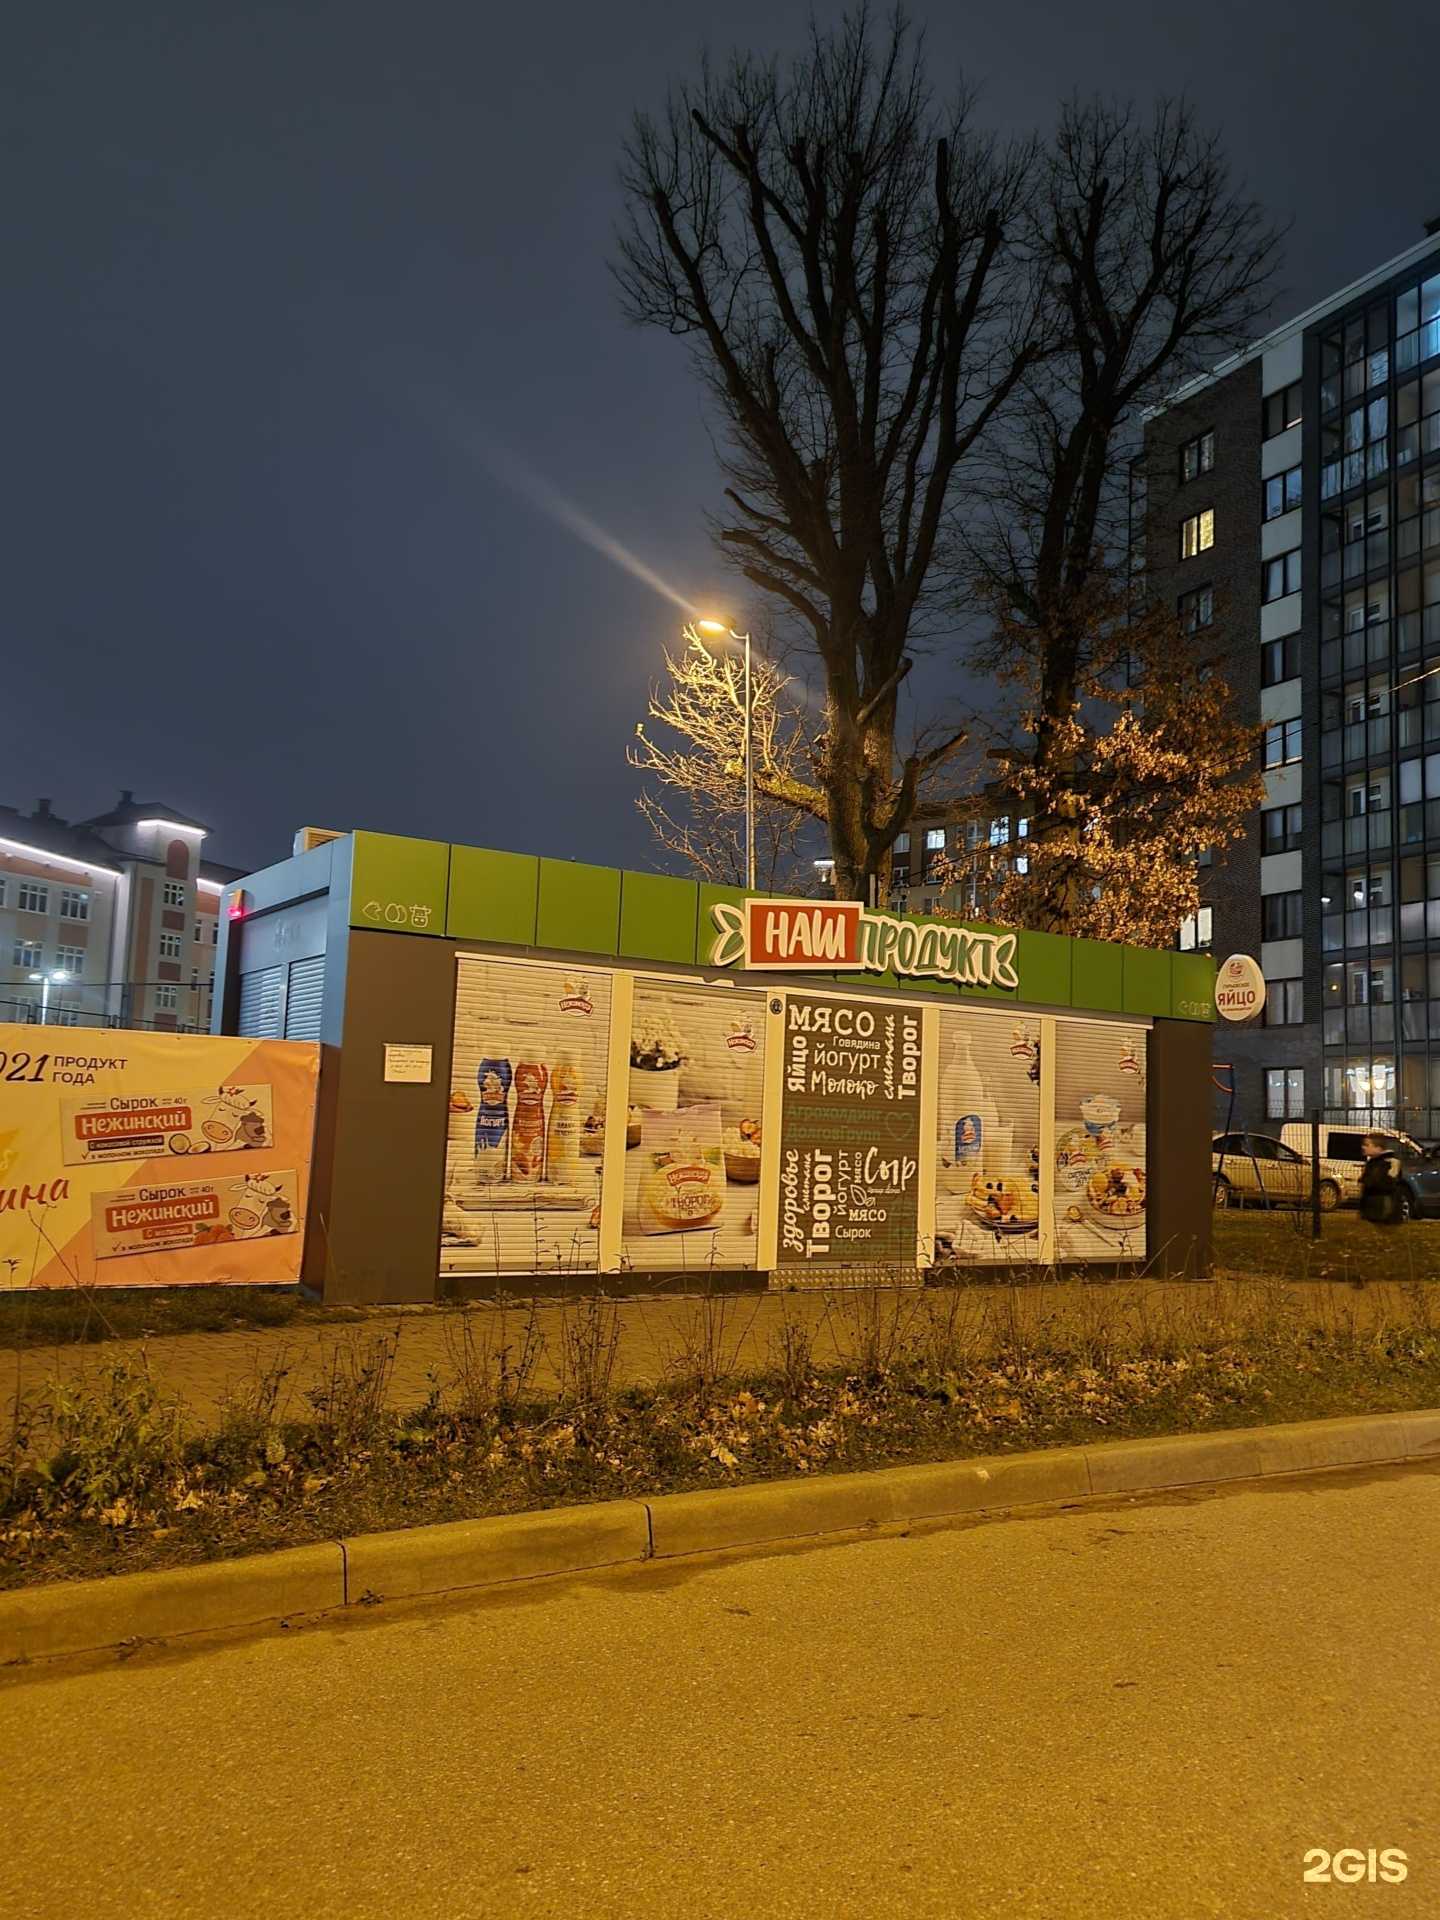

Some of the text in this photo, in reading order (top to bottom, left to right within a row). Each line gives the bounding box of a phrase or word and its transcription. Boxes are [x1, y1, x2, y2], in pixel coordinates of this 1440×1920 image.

[765, 909, 998, 986] НАШ ПРОДУКТ
[1217, 989, 1256, 1006] ЯЙЦО
[54, 1056, 128, 1070] ПРОДУКТ
[52, 1071, 95, 1086] ГОДА
[110, 1097, 158, 1110] Сырок
[81, 1110, 187, 1136] Нежинский
[864, 1146, 916, 1191] Сыр
[139, 1187, 186, 1202] Сырок
[111, 1199, 214, 1228] Нежинский
[835, 1225, 872, 1242] Сырок
